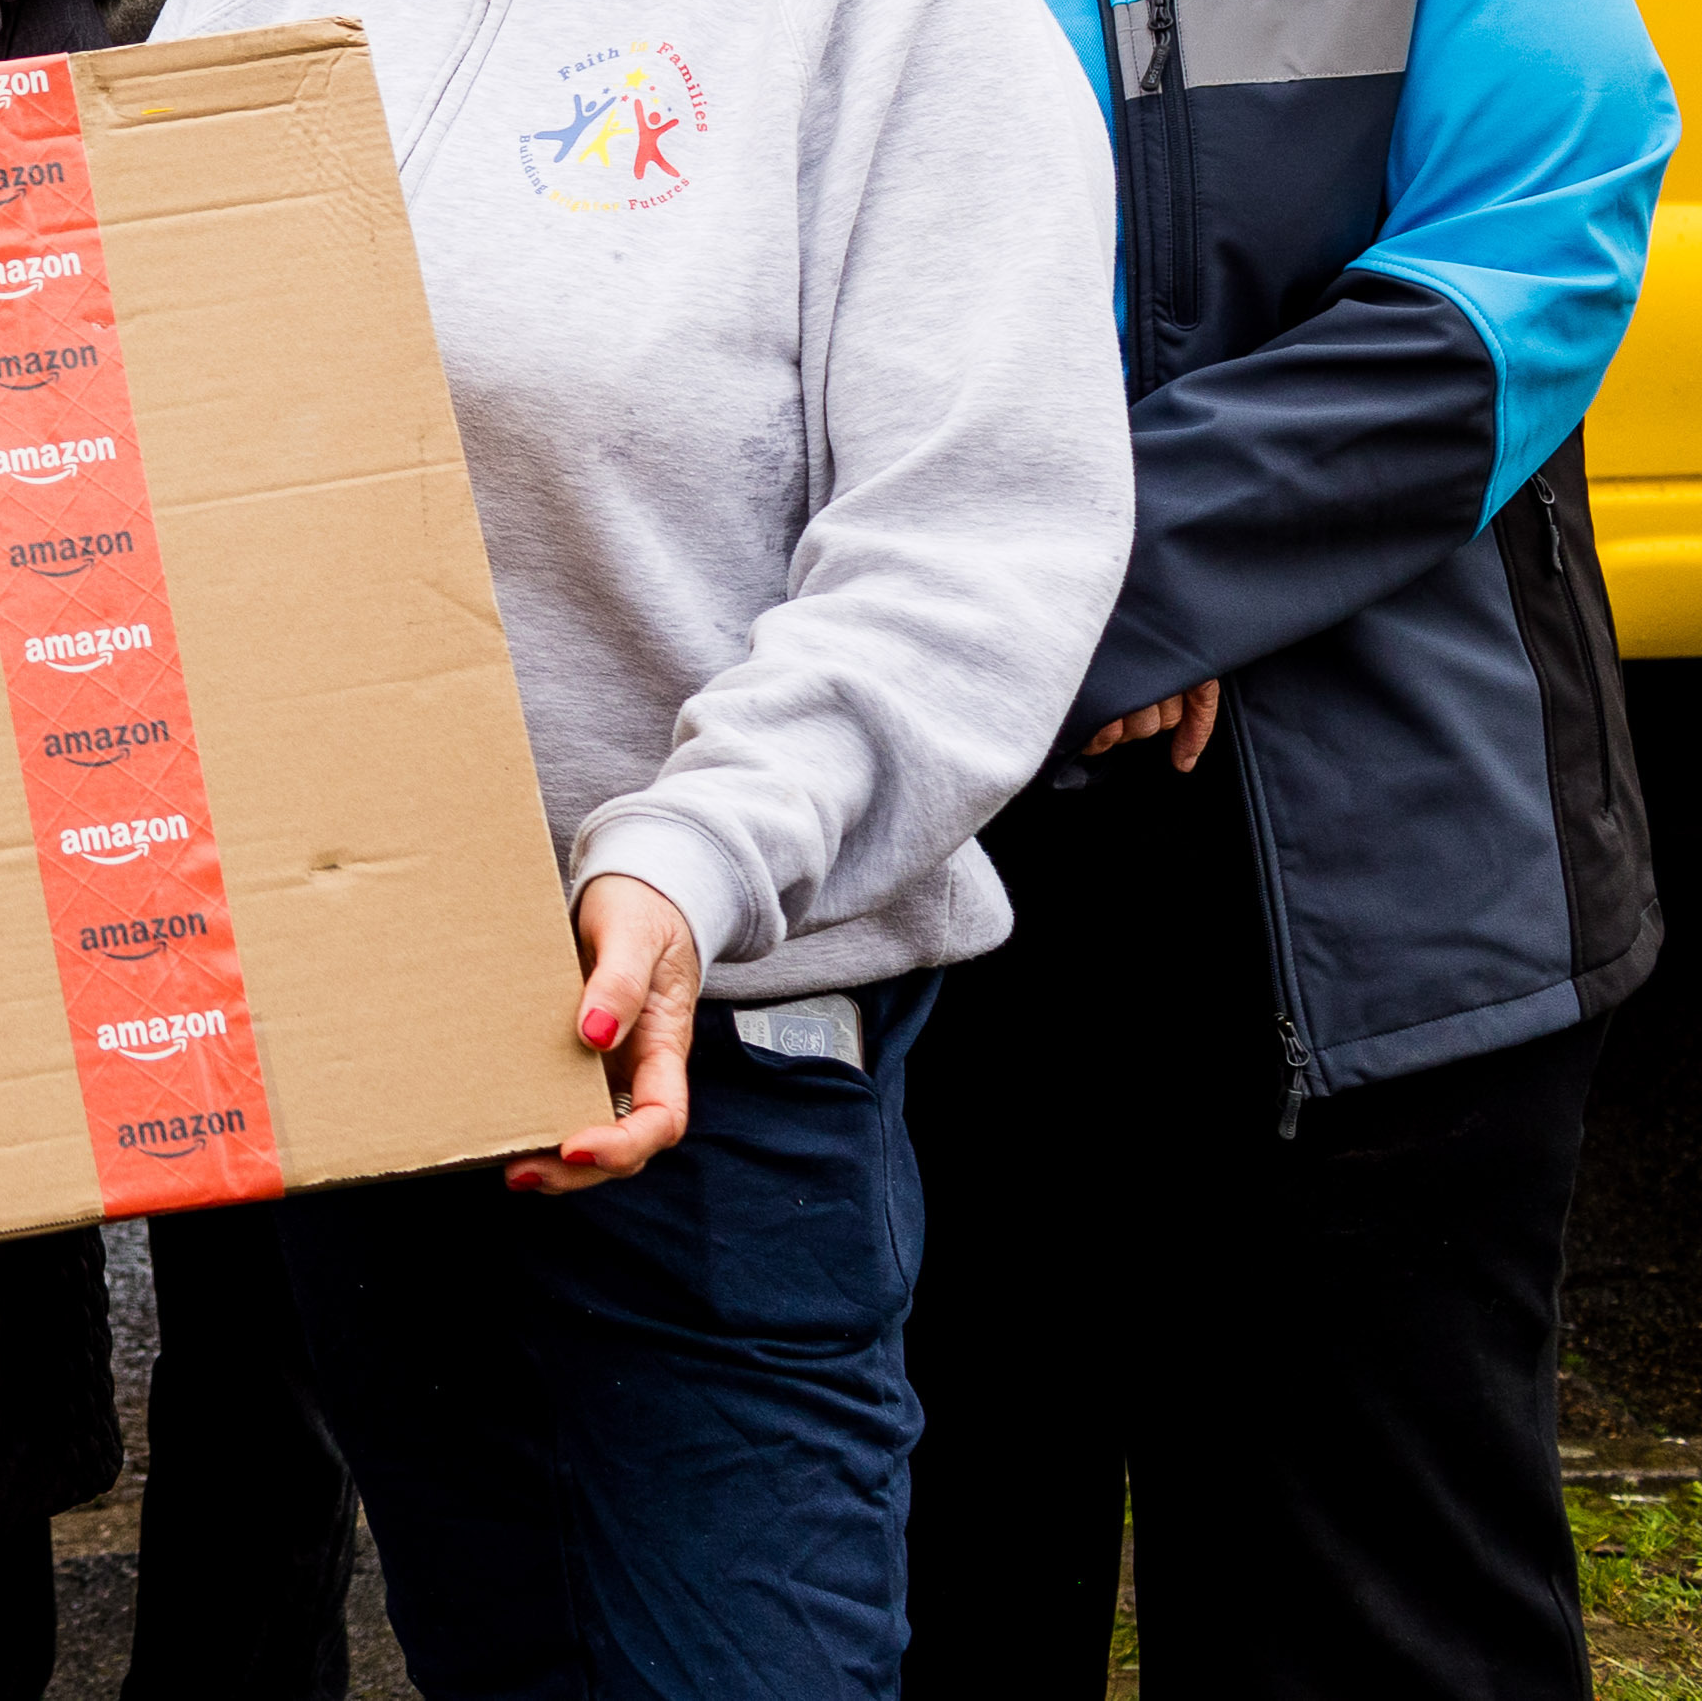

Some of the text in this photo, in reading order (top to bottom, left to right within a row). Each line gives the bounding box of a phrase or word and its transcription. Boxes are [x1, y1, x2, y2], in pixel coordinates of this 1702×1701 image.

[556, 47, 621, 82] Faith
[656, 41, 709, 133] Families
[519, 134, 549, 195] Building
[628, 177, 690, 210] Futures
[9, 529, 134, 568] amazon
[24, 623, 152, 663] amazon
[43, 718, 171, 759] amazon
[60, 814, 189, 855] amazon
[80, 910, 208, 953] amazon
[97, 1007, 227, 1051] amazon
[117, 1106, 247, 1150] amazon
